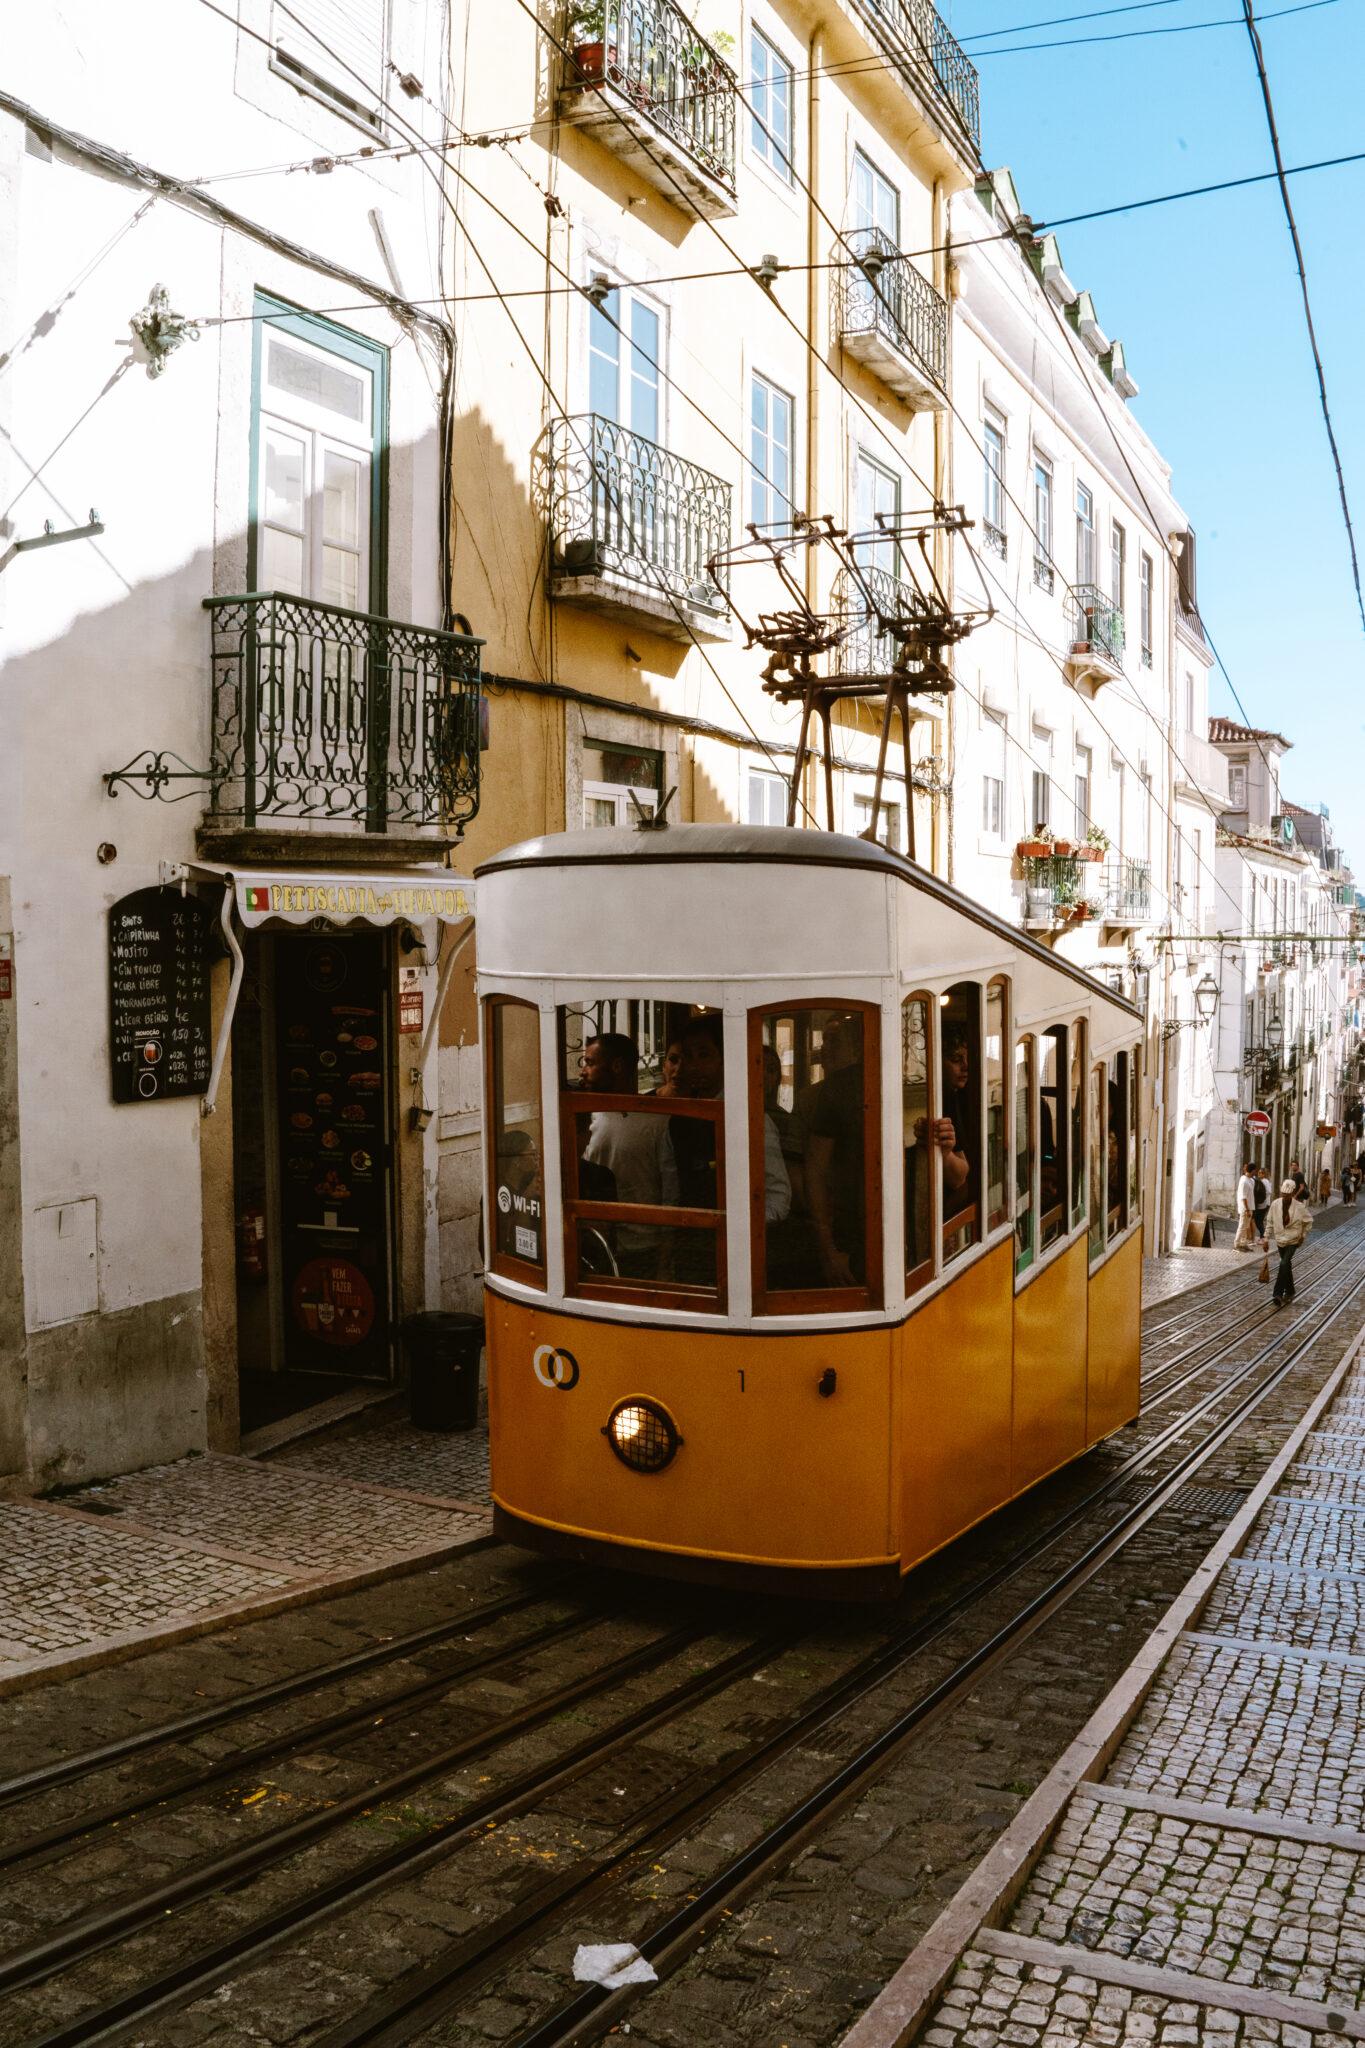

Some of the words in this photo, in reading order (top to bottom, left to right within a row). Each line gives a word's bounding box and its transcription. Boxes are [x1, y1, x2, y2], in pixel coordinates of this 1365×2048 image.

[271, 885, 377, 914] PETISCARIA
[121, 915, 143, 928] SHOTS
[513, 1194, 540, 1217] WI-FI
[737, 1369, 745, 1393] 1
